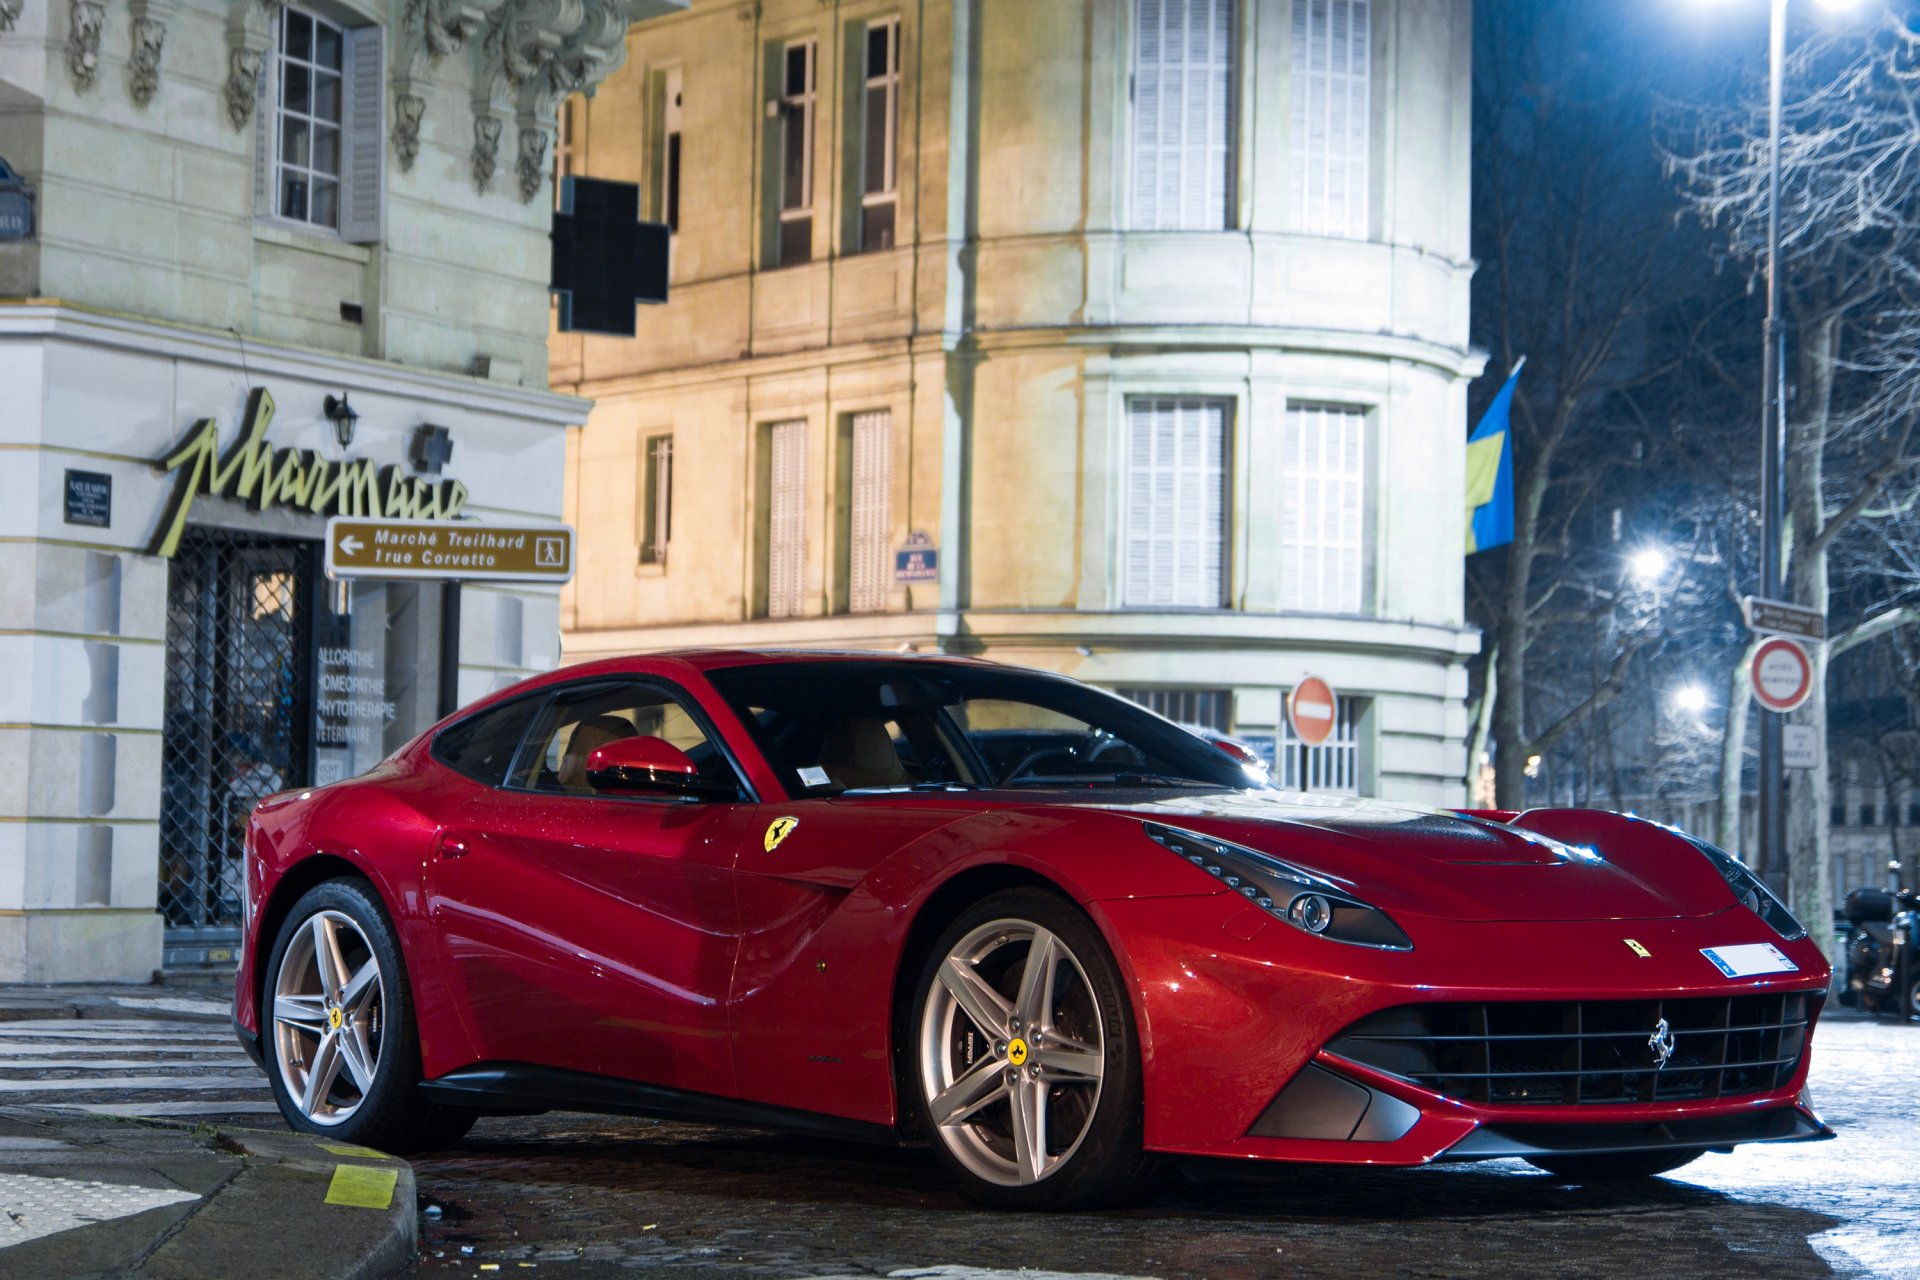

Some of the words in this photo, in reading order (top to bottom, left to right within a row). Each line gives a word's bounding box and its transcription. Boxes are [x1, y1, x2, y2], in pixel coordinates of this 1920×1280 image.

[375, 529, 437, 546] Marché
[449, 531, 525, 549] Treilhard
[422, 550, 495, 567] Corvetto
[318, 647, 375, 669] ALLOPATHIE
